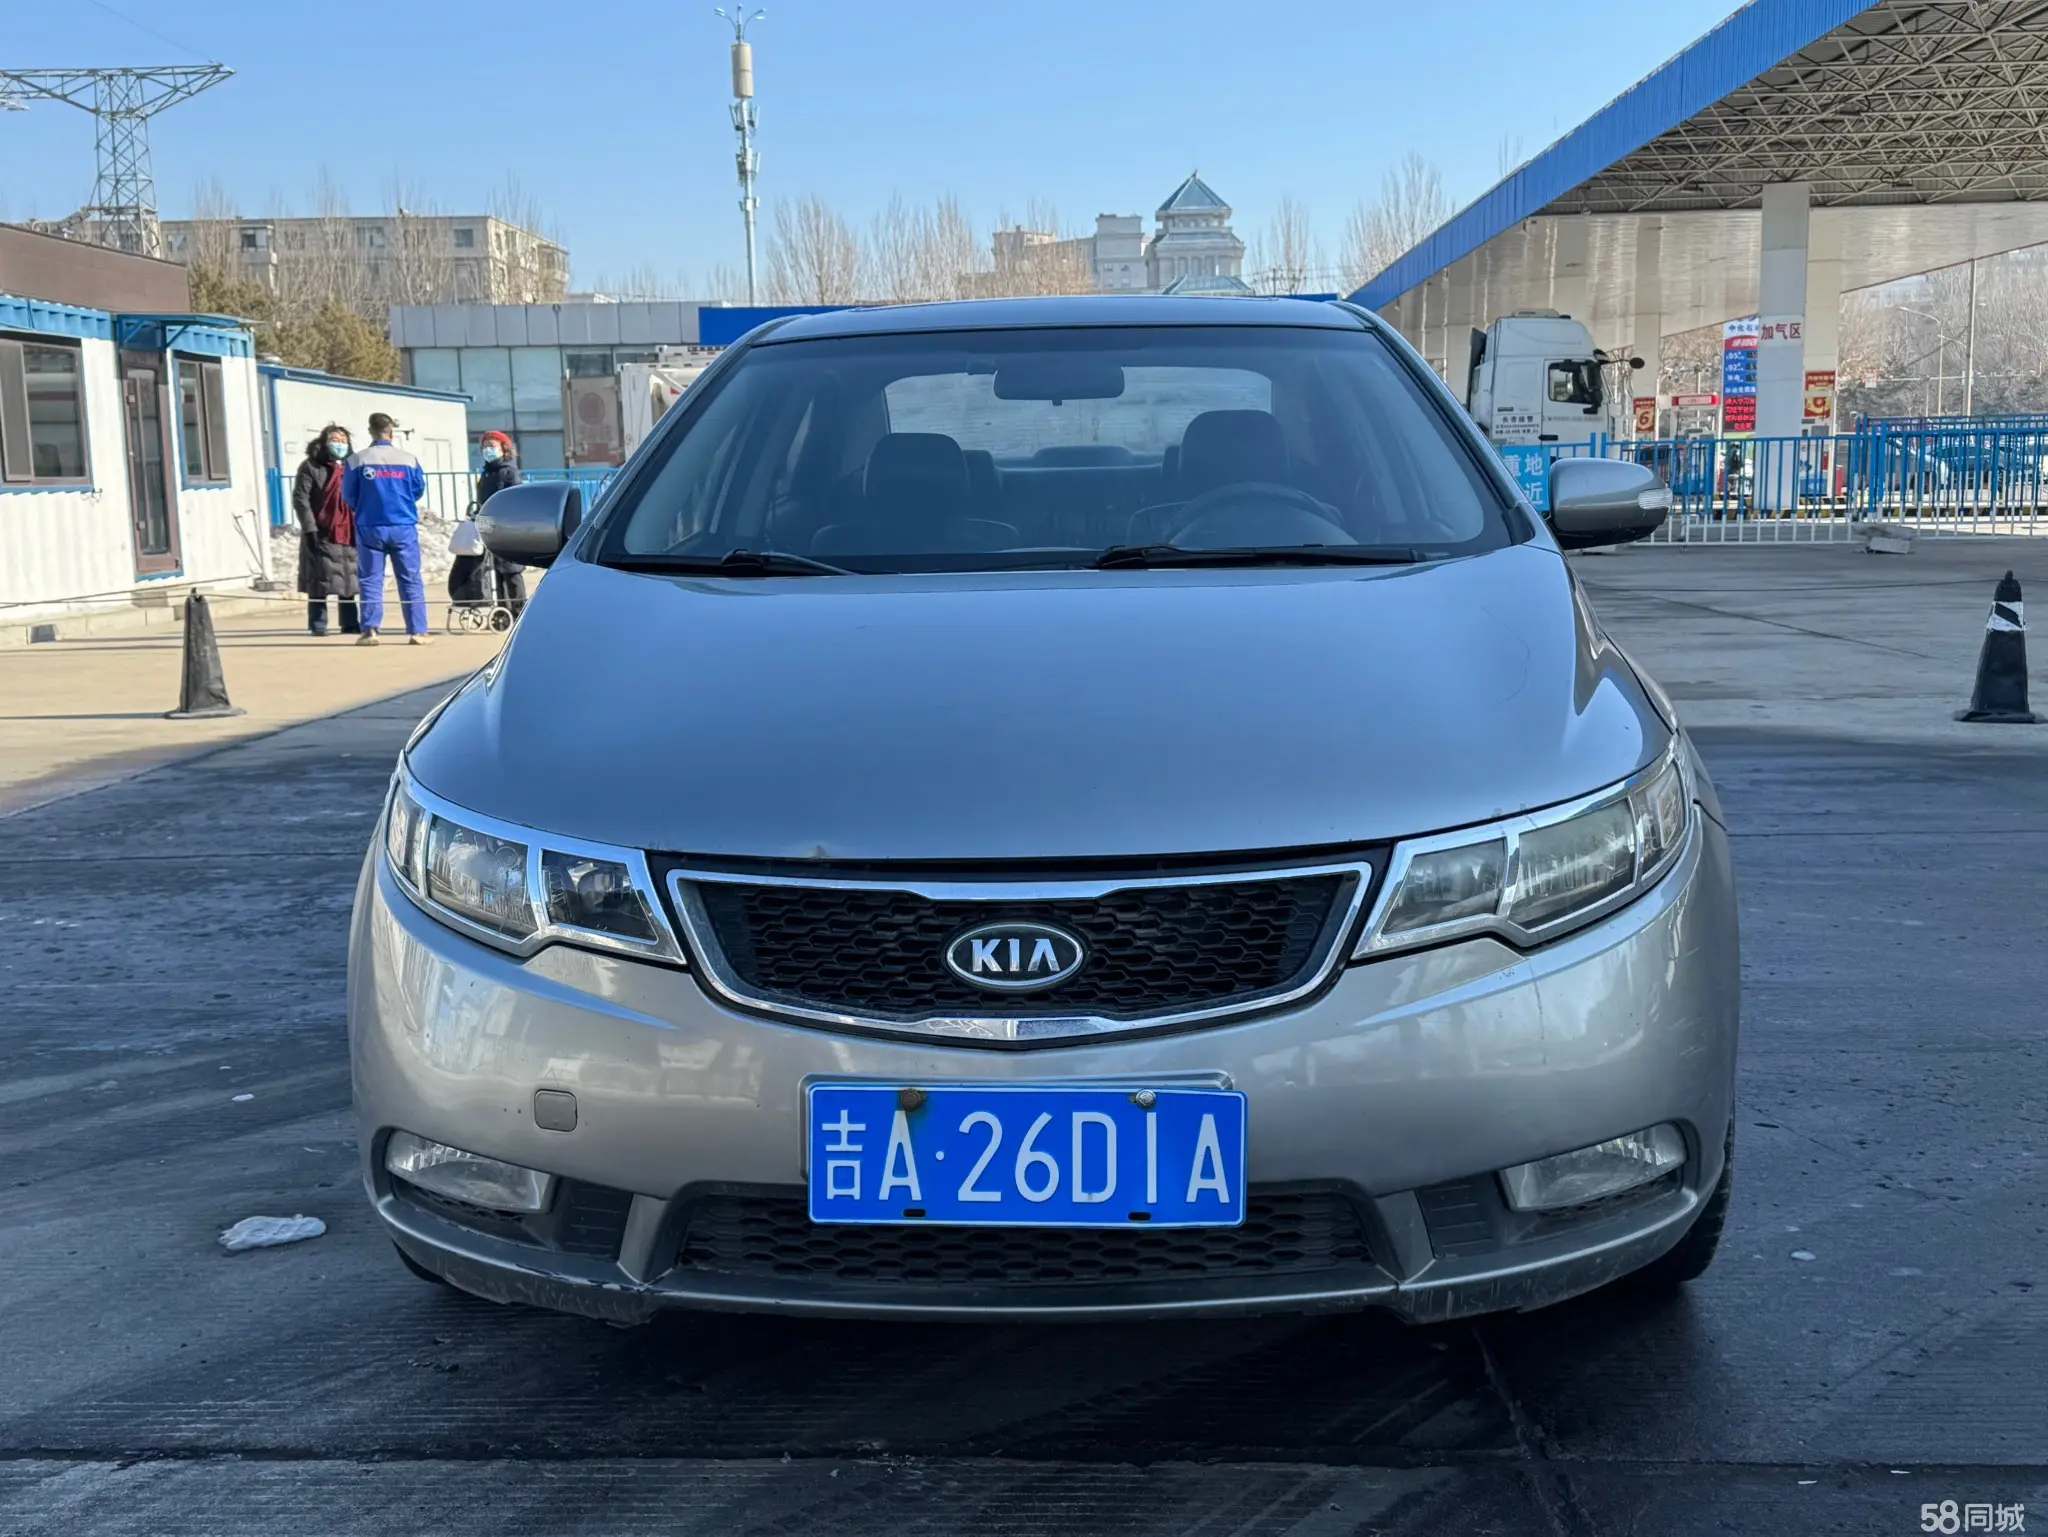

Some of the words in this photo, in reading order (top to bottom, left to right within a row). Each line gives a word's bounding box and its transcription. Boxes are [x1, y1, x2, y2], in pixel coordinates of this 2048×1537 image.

[1760, 323, 1802, 340] 加气区
[971, 938, 1061, 972] KIA
